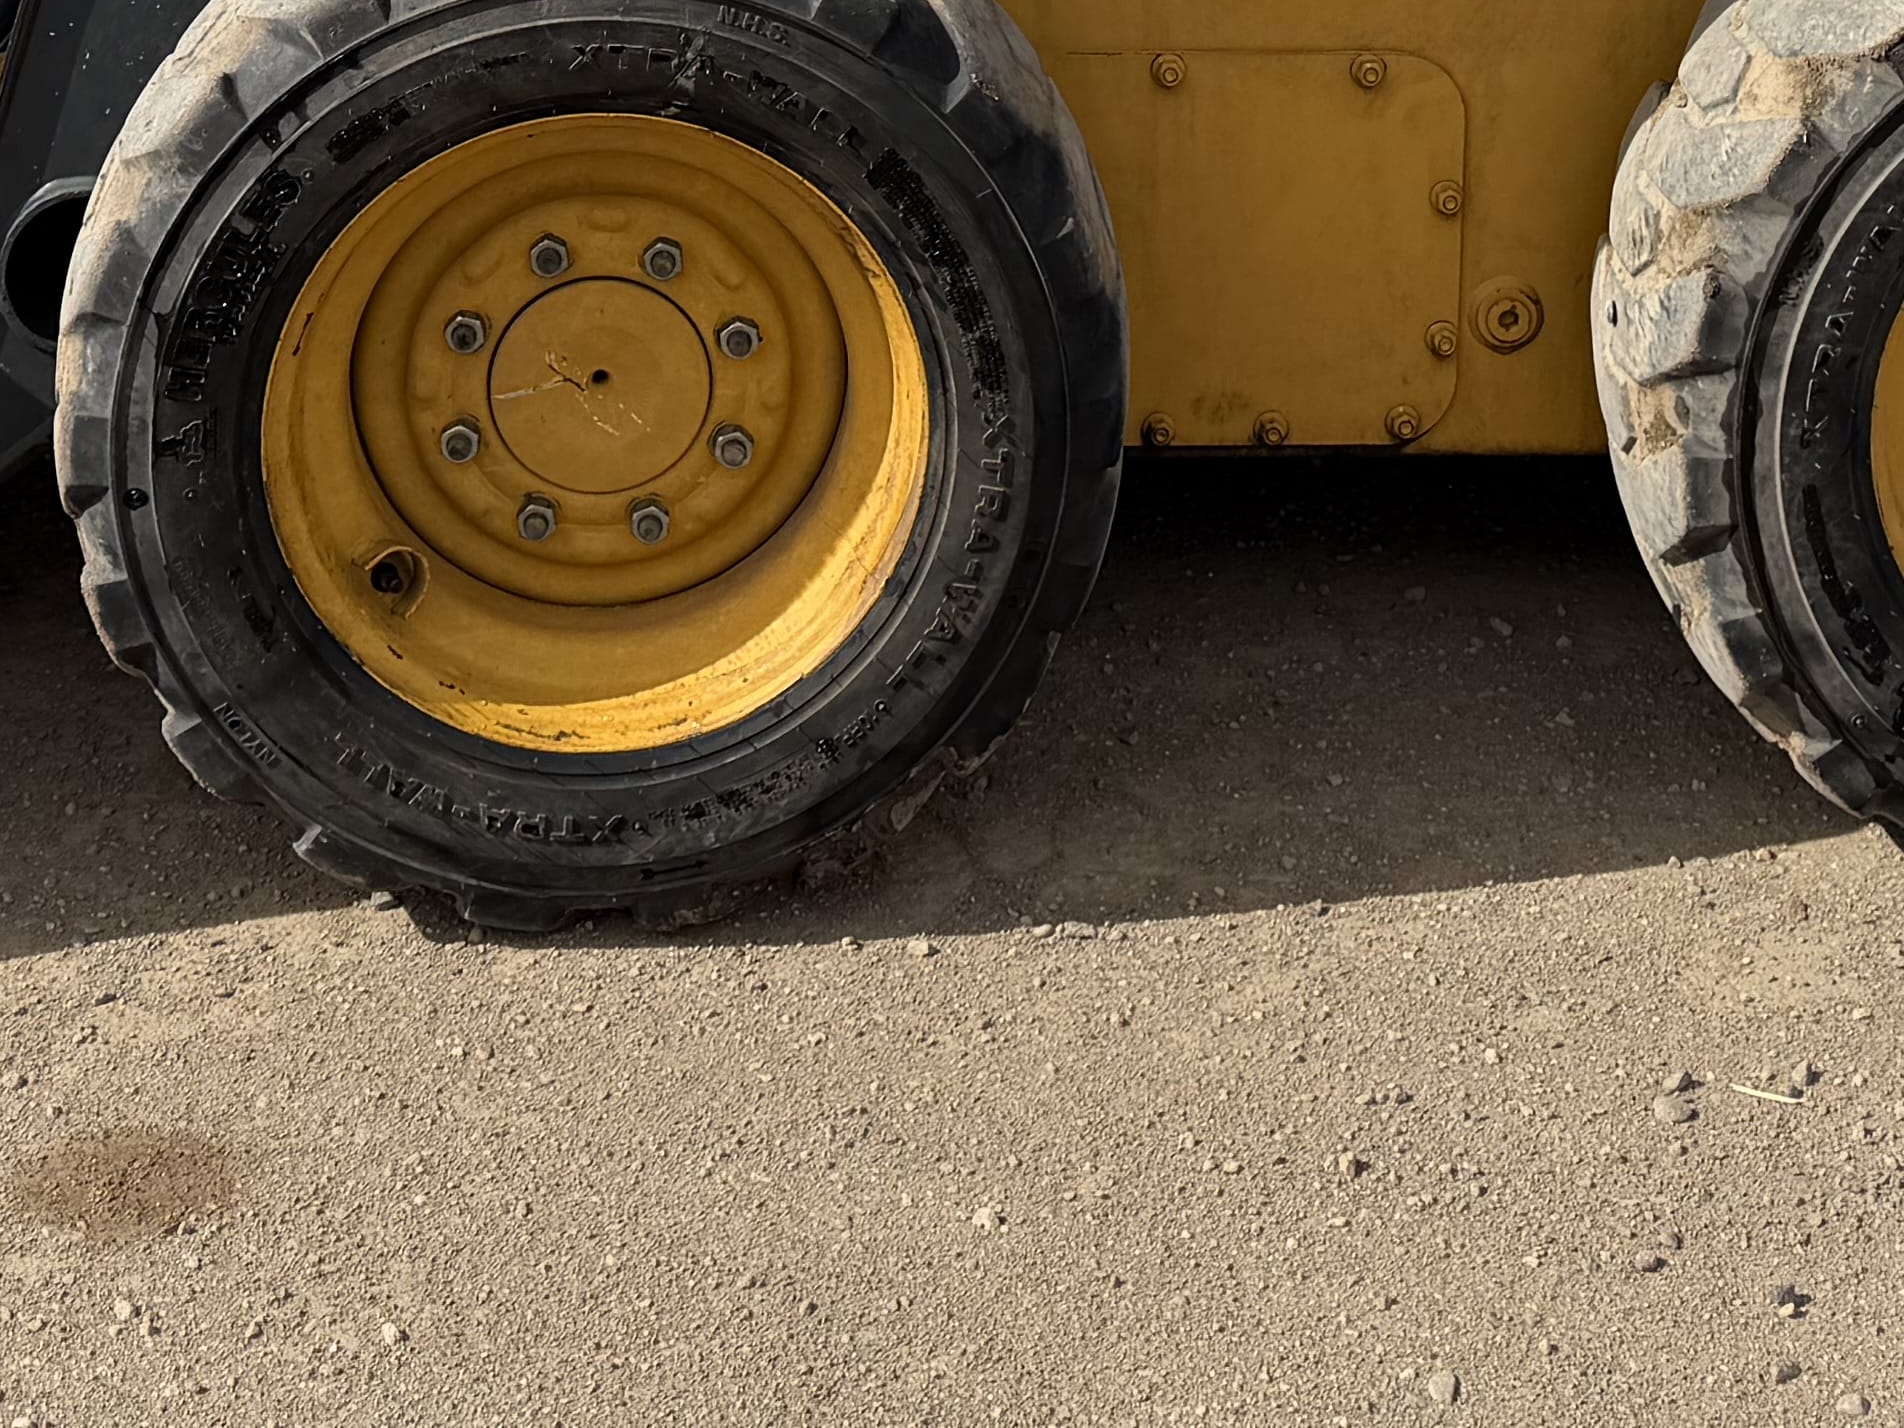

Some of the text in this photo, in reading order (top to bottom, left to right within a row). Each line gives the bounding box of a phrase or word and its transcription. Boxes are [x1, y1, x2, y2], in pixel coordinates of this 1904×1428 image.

[164, 166, 303, 401] HERCULES
[885, 414, 1016, 693] XTRA-WALL
[212, 700, 284, 770] NYLON
[334, 744, 626, 844] XTRA-WALL
